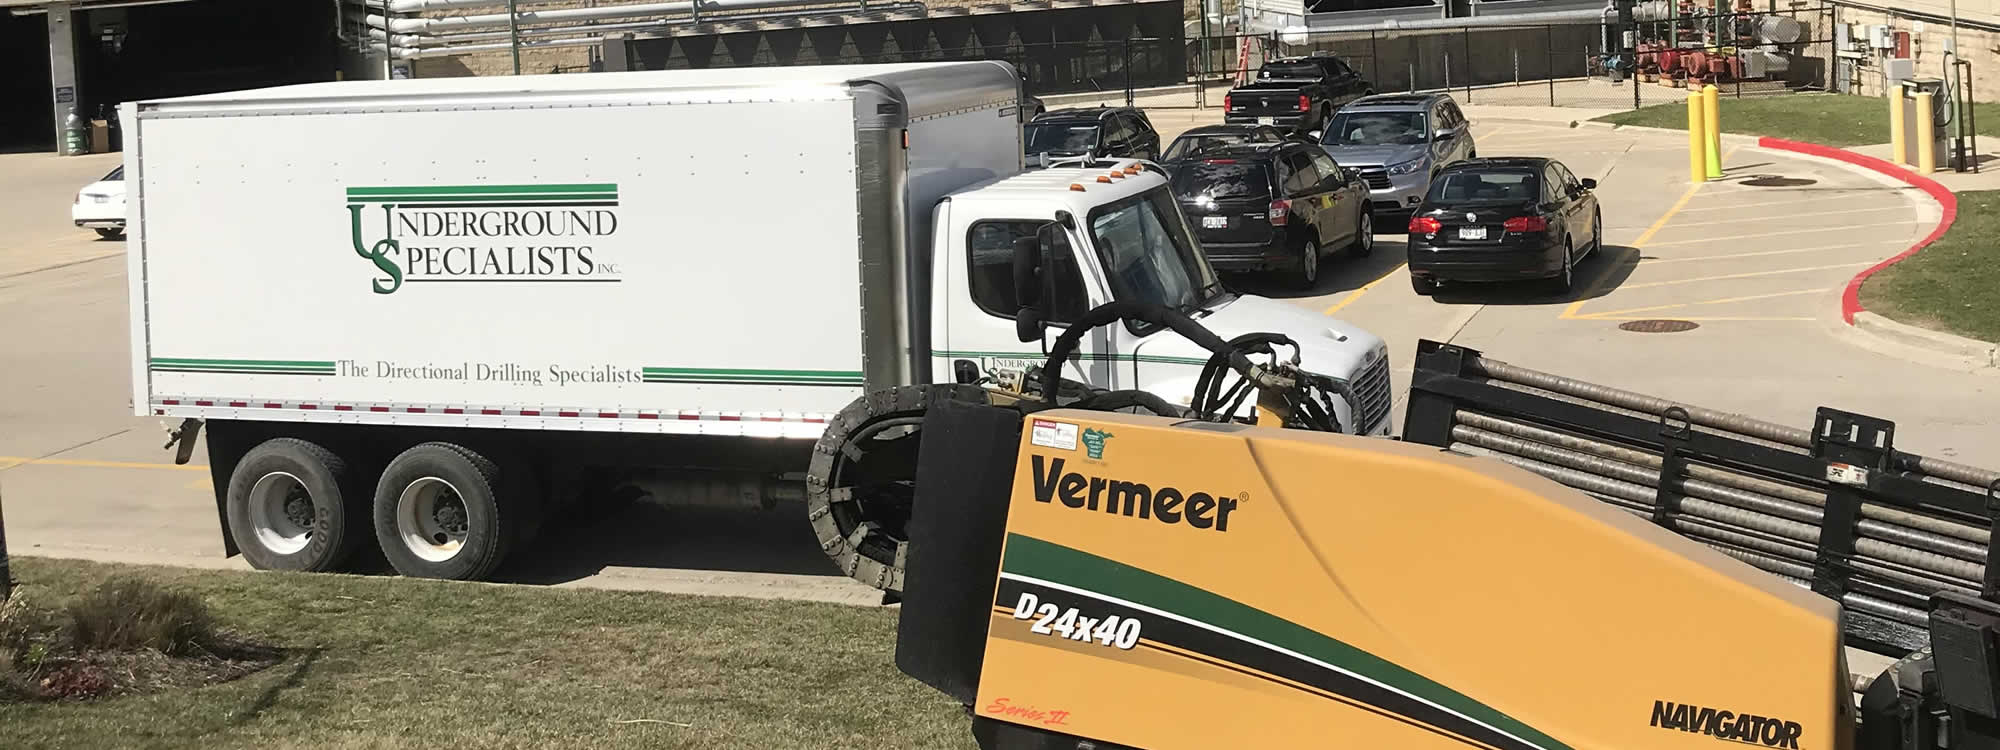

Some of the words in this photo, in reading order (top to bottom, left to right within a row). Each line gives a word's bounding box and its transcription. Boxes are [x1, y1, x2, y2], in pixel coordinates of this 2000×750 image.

[346, 204, 618, 259] UNDERGROUND
[372, 239, 594, 294] SPECIALISTS
[338, 360, 369, 378] The
[377, 360, 469, 381] Directional
[476, 363, 542, 386] Drilling
[549, 364, 642, 386] Specialists
[1031, 454, 1238, 532] Vermeer
[1014, 592, 1142, 650] D24x40
[985, 697, 1046, 720] Series
[1043, 709, 1070, 725] II
[1650, 700, 1803, 750] NAVIGATOR
